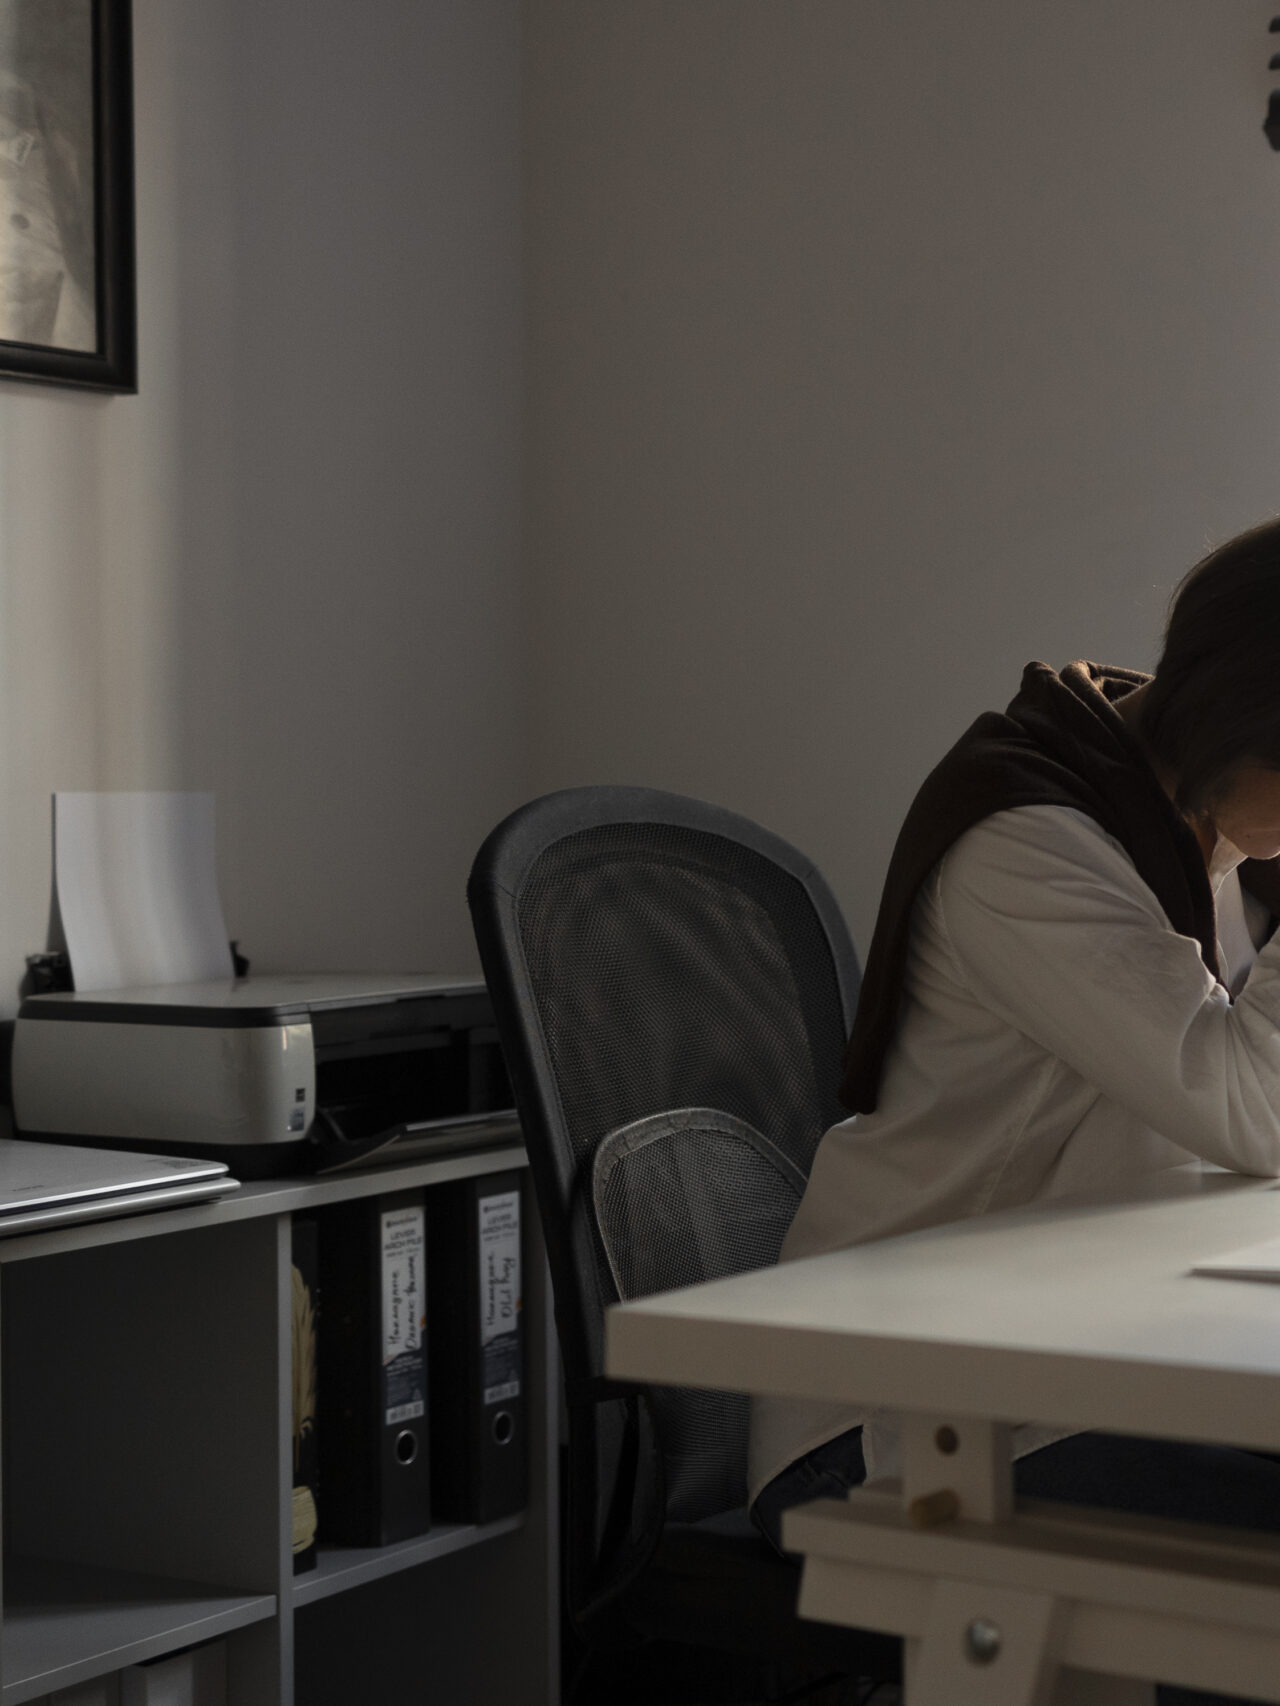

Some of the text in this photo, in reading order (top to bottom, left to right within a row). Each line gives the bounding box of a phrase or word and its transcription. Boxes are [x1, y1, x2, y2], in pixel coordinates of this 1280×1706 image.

[390, 1228, 416, 1240] LEVER
[383, 1236, 422, 1250] ARCH FILE
